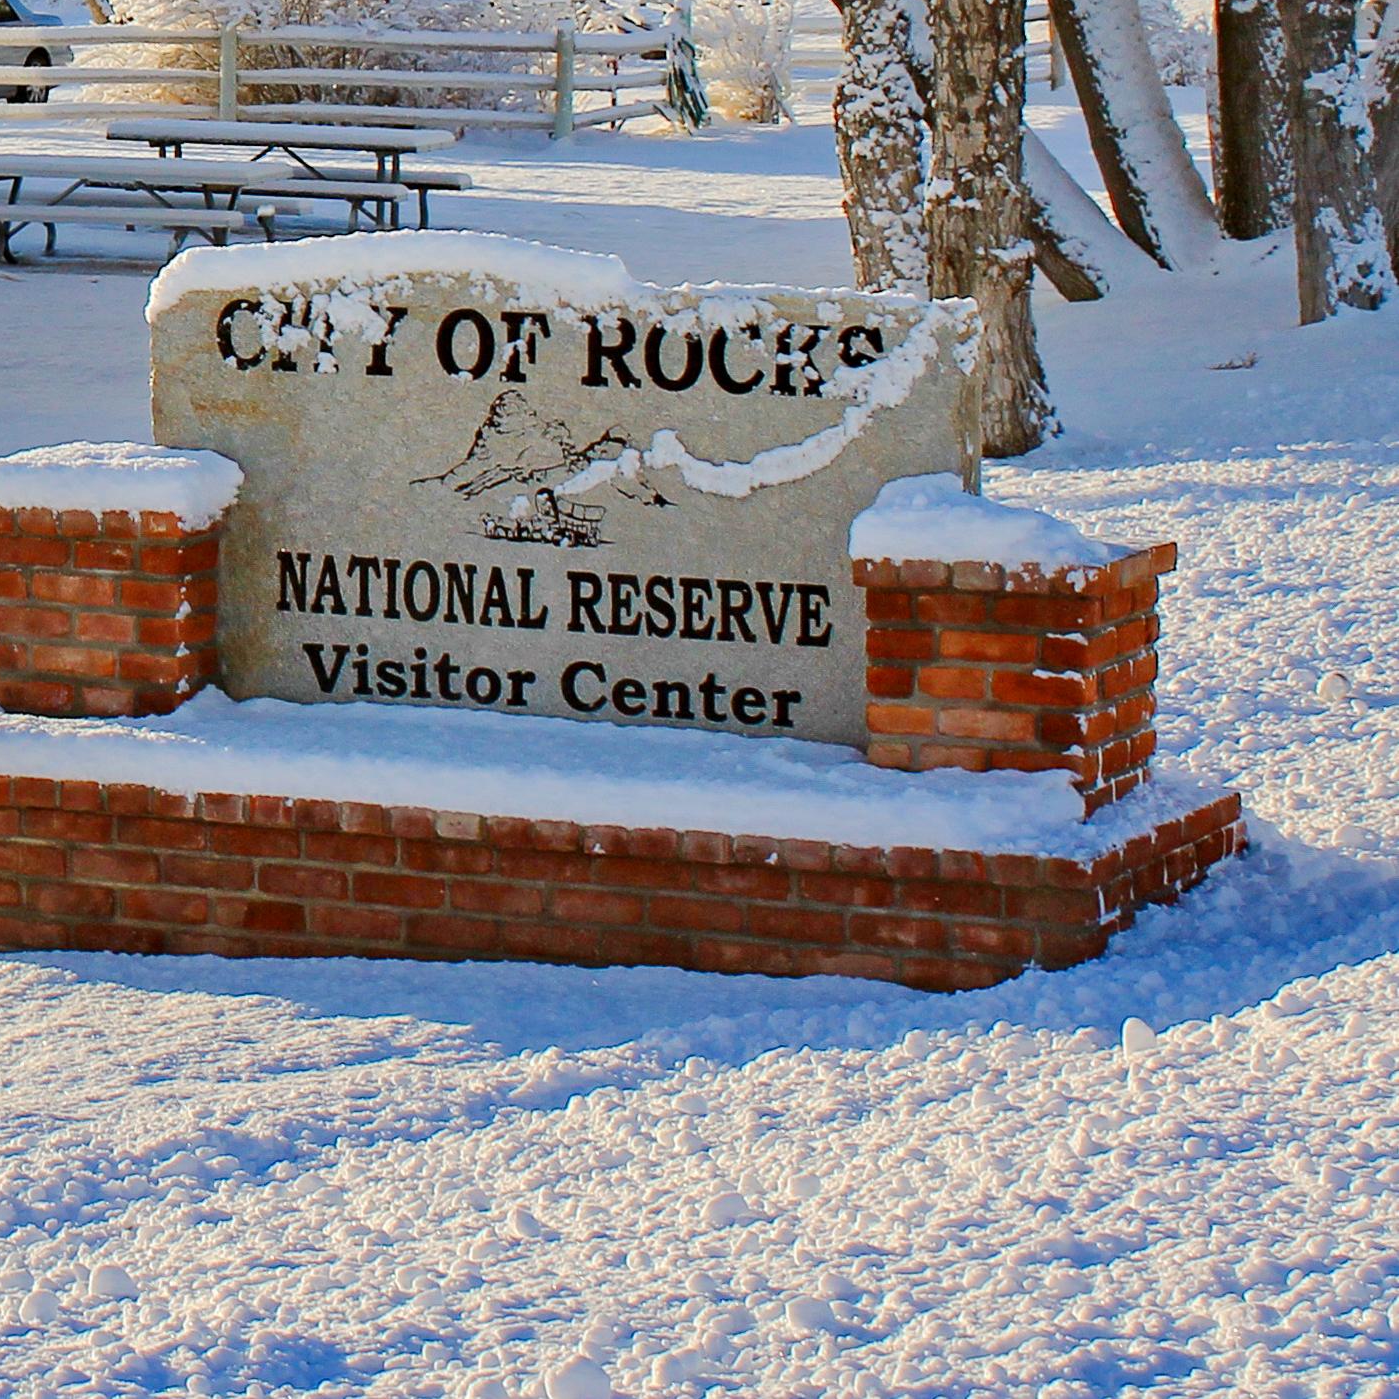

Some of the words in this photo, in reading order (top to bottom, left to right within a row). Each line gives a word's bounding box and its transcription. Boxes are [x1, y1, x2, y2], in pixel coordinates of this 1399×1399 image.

[436, 308, 551, 382] OF
[581, 314, 885, 397] ROCKS
[276, 551, 549, 630] NATIONAL
[566, 570, 833, 648] RESERVE
[303, 642, 537, 707] Visitor
[561, 660, 802, 728] Center
